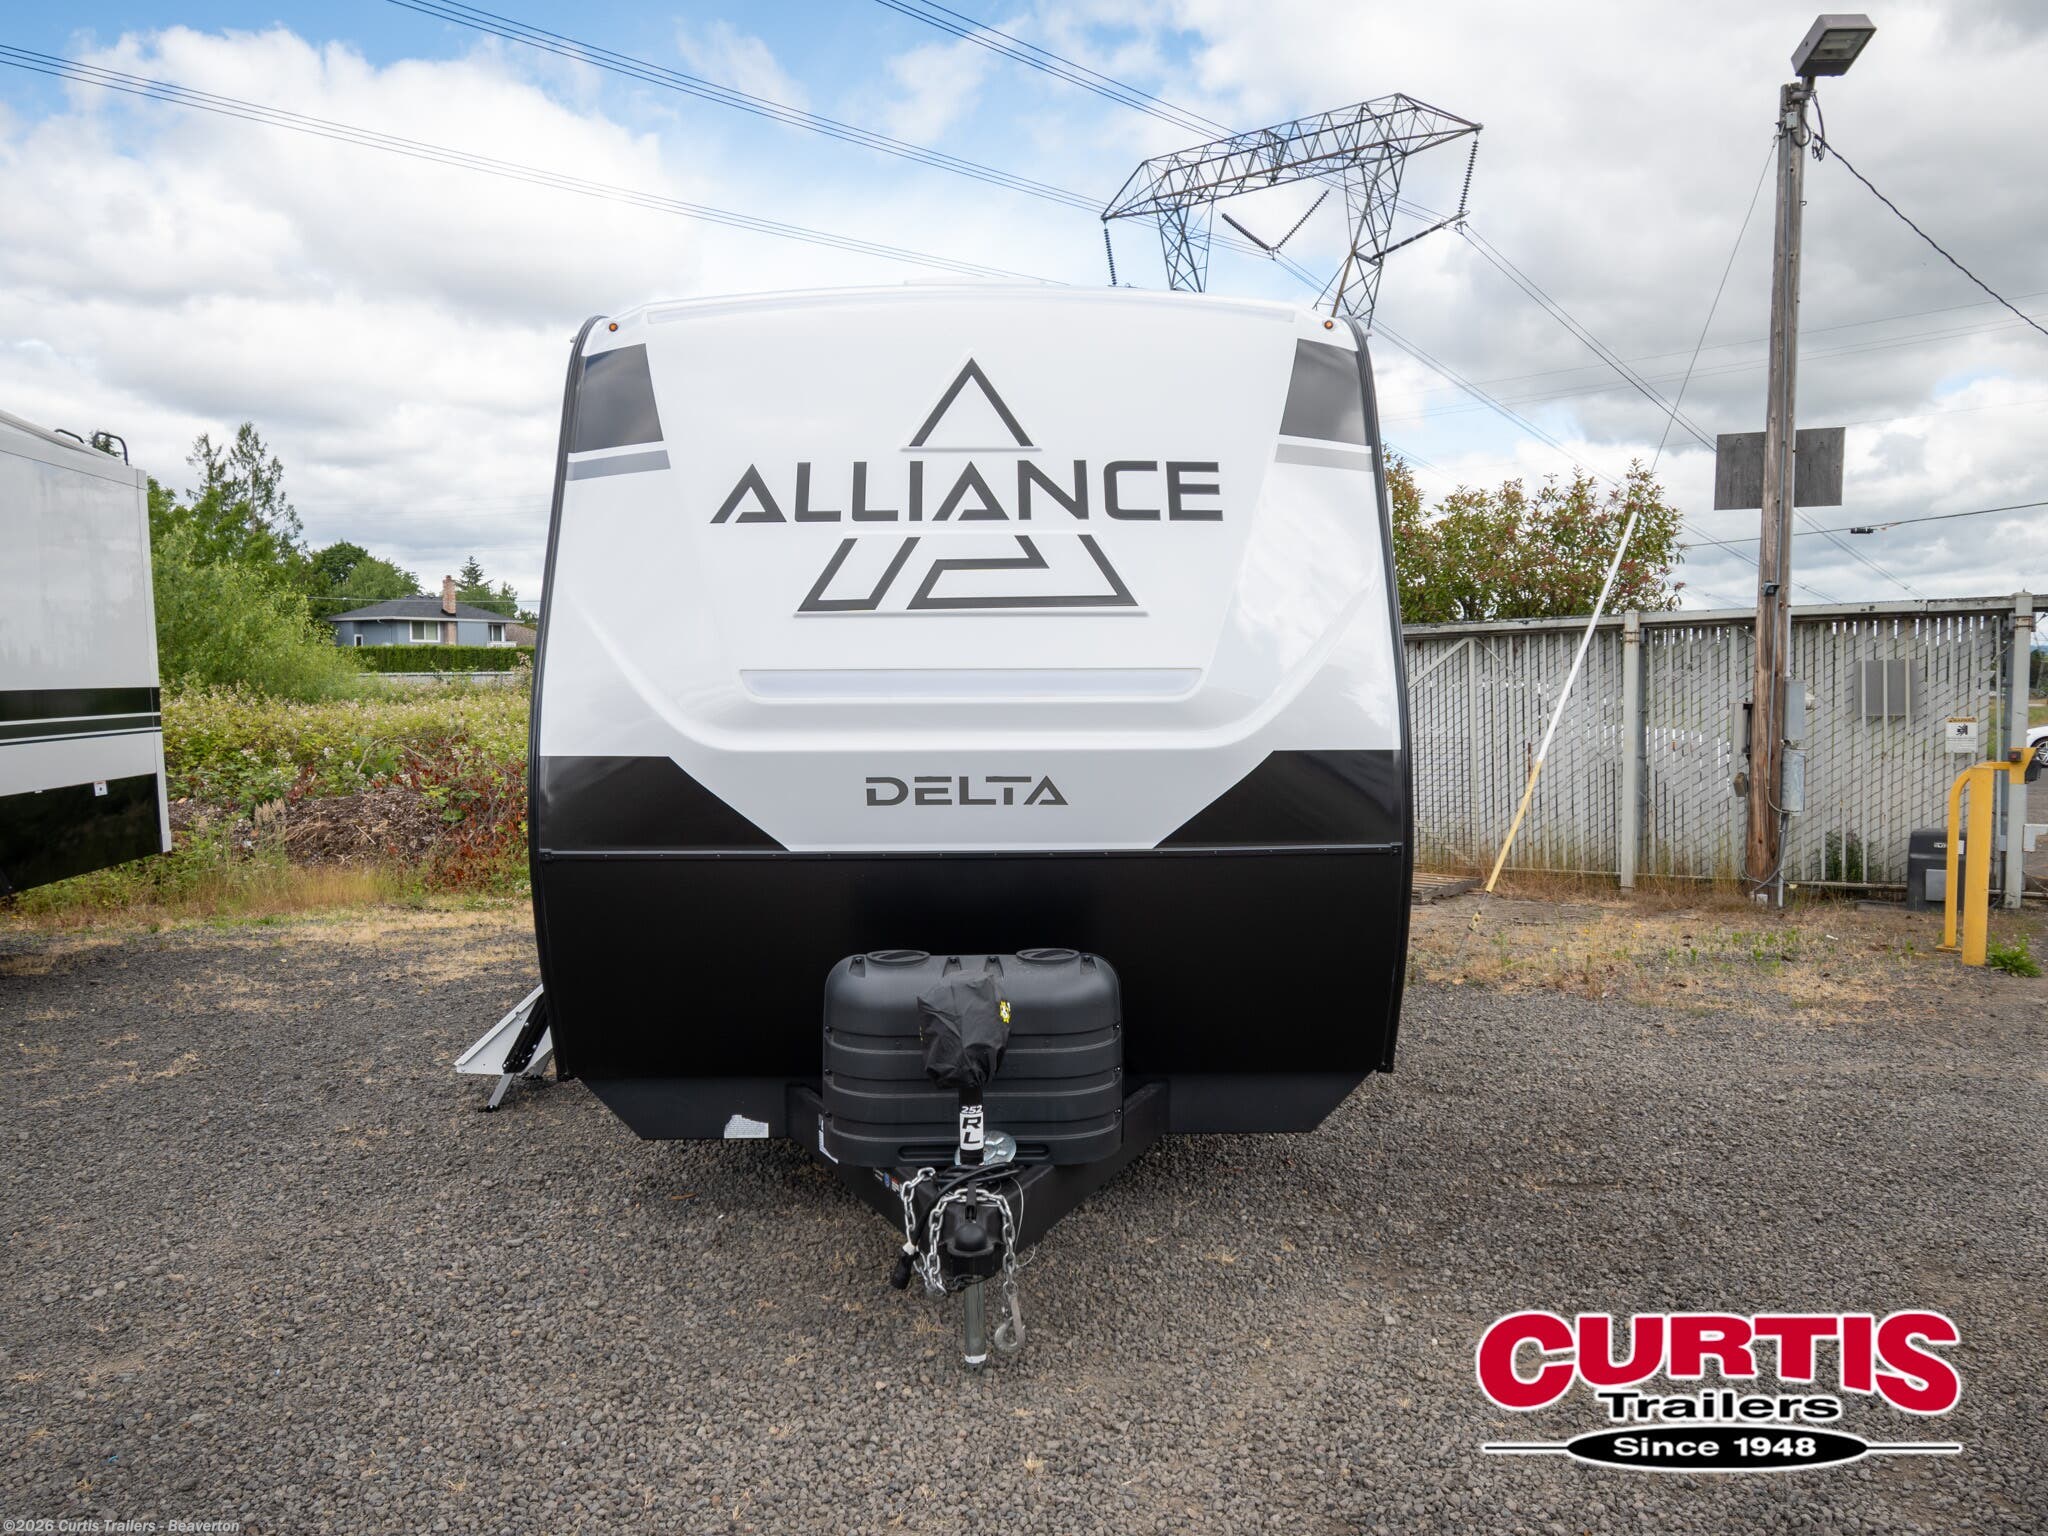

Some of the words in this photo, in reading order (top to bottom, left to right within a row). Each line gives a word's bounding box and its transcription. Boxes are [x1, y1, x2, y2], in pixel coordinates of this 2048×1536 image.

[709, 460, 1223, 523] ALLIANCE
[865, 775, 1069, 806] DELTA
[960, 1104, 983, 1114] 252
